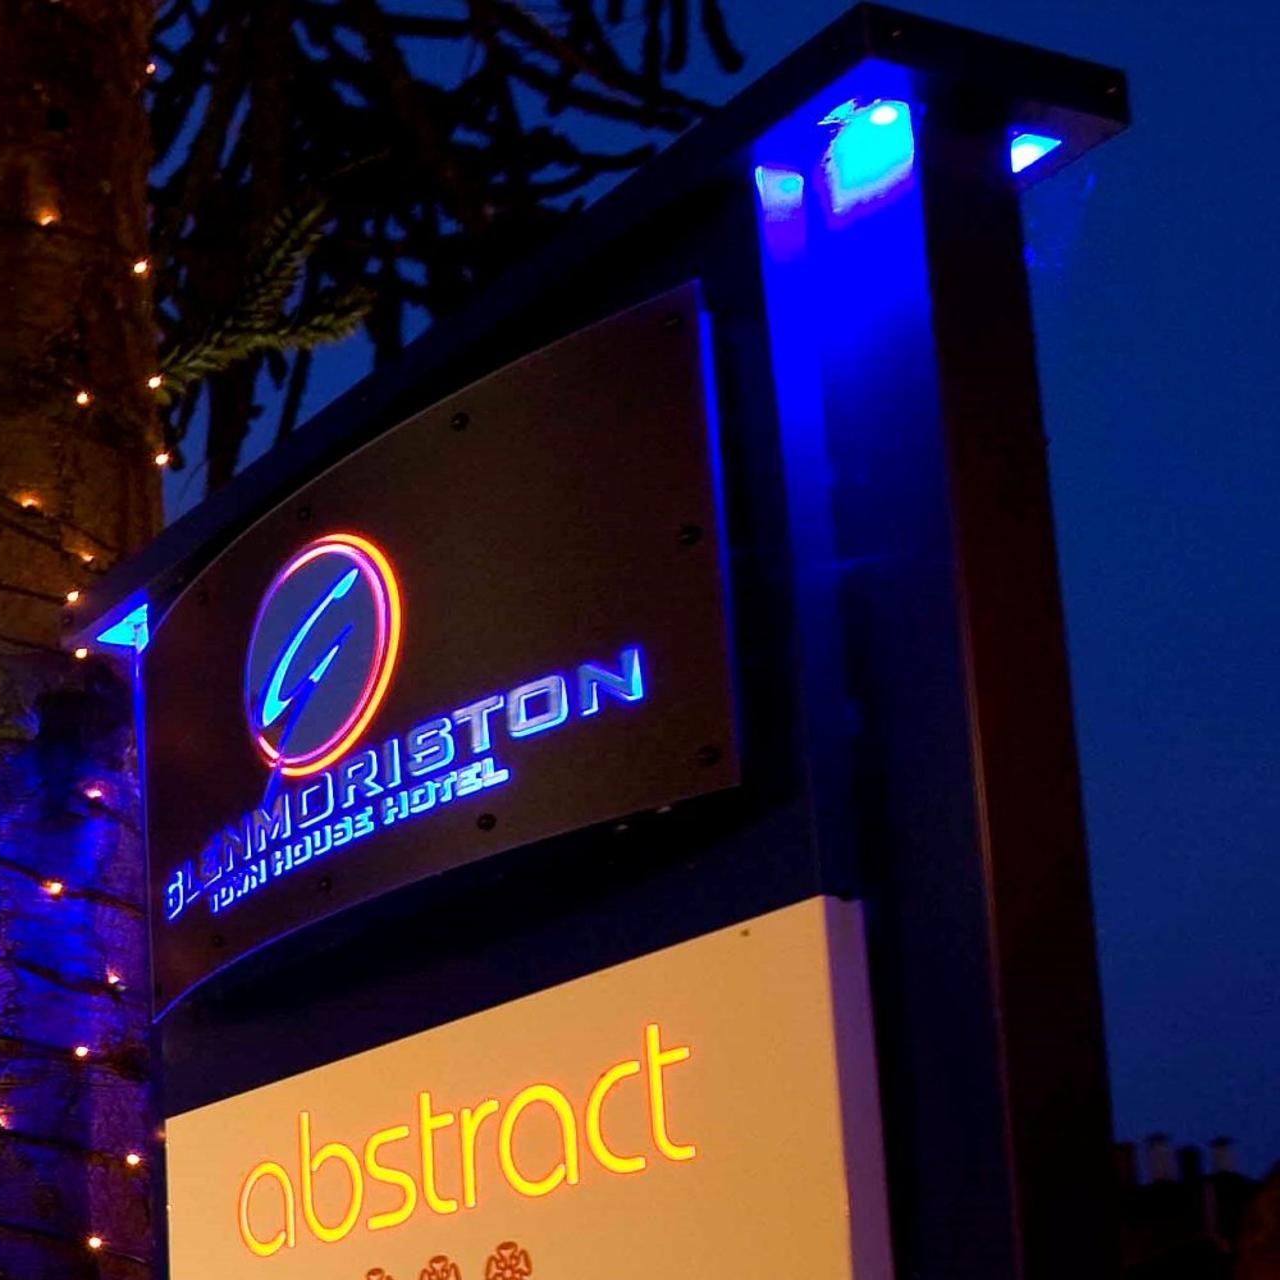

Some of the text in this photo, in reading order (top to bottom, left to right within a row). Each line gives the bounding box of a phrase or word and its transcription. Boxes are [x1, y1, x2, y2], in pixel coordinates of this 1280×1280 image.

[273, 806, 376, 876] HOUSE
[384, 757, 510, 825] HOTEL
[239, 1023, 696, 1256] abstract
